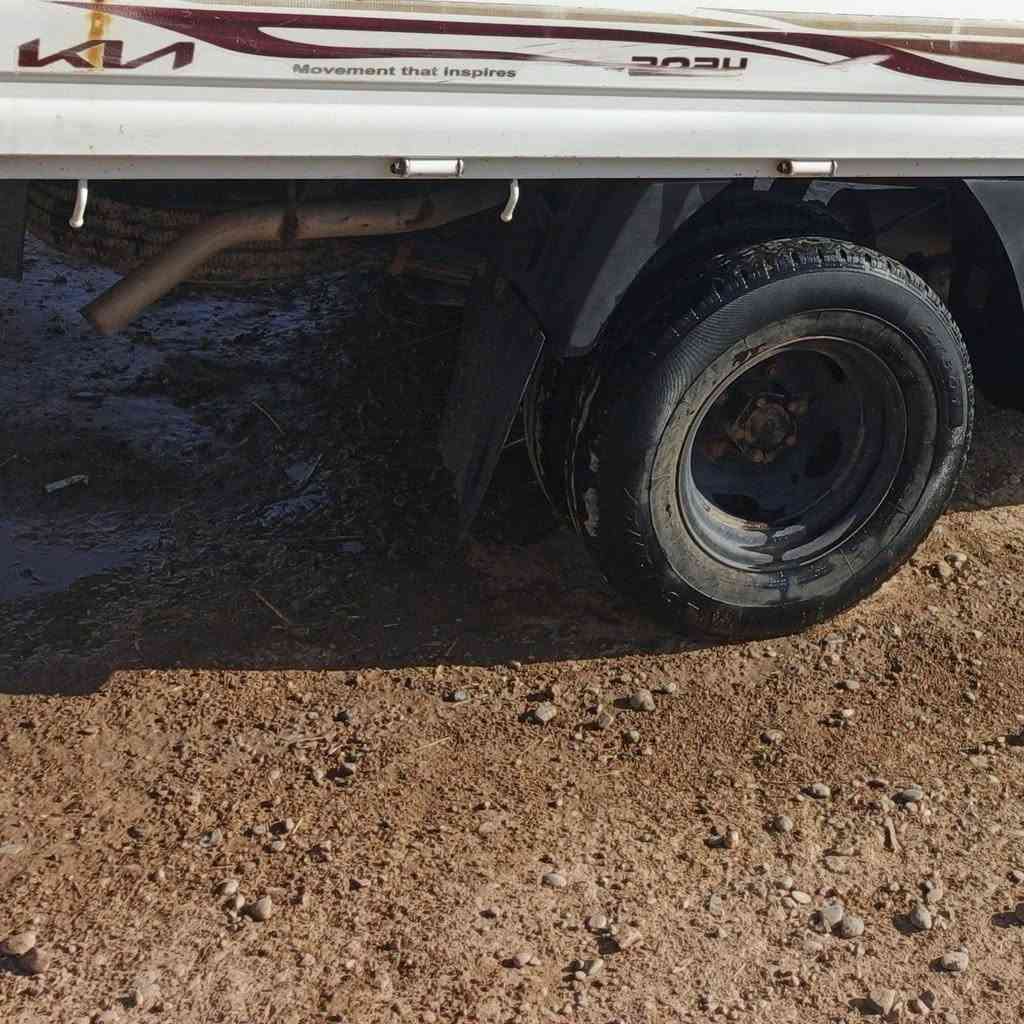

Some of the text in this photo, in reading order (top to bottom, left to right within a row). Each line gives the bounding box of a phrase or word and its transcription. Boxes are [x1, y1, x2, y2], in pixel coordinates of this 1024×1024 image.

[18, 38, 195, 70] KIA
[292, 63, 396, 76] Movement
[401, 66, 439, 76] that
